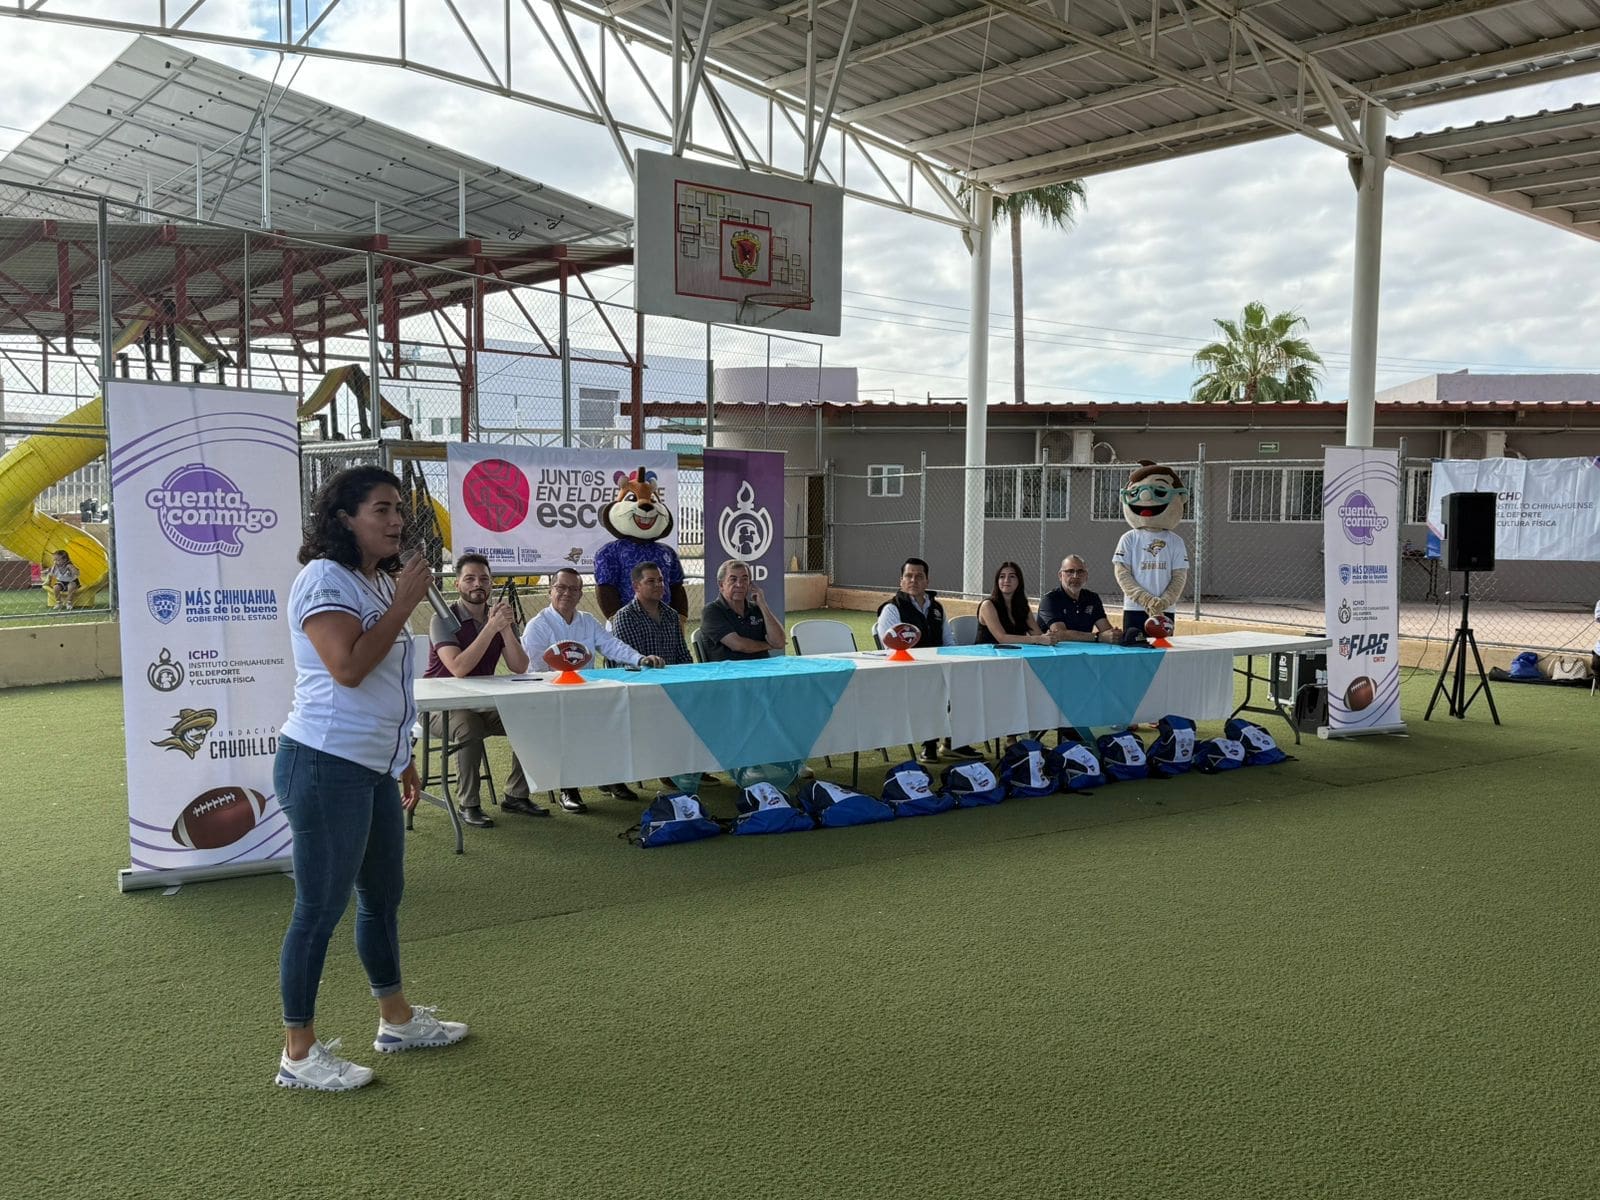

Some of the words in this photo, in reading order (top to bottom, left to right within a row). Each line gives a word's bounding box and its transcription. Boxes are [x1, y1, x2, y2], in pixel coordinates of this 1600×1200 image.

[538, 469, 605, 486] JUNT@S
[146, 488, 242, 508] cuenta
[536, 486, 561, 502] EN
[566, 487, 586, 502] EL
[591, 487, 665, 502] DEPE
[1498, 492, 1522, 501] CHD
[1339, 505, 1375, 517] cuenta
[1531, 502, 1593, 510] CHIHUAHUENSE
[166, 503, 277, 532] conmigo
[1345, 515, 1388, 531] conmigo
[185, 587, 211, 606] MÁS
[214, 589, 277, 605] CHIHUAHUA
[186, 605, 211, 615] más
[213, 606, 228, 614] de
[231, 605, 240, 614] lo
[243, 604, 278, 613] bueno
[186, 614, 230, 623] GOBIERNO
[248, 613, 278, 621] ESTADO
[188, 650, 219, 660] ICHD
[188, 661, 228, 669] INSTITUTO
[230, 658, 285, 668] CHIHUAHUENSE
[205, 669, 240, 677] DEPORTE
[197, 677, 231, 685] CULTURA
[233, 676, 256, 684] FÍSICA
[210, 726, 276, 738] FUNDACIÓ
[210, 737, 277, 759] CAUDILLO
